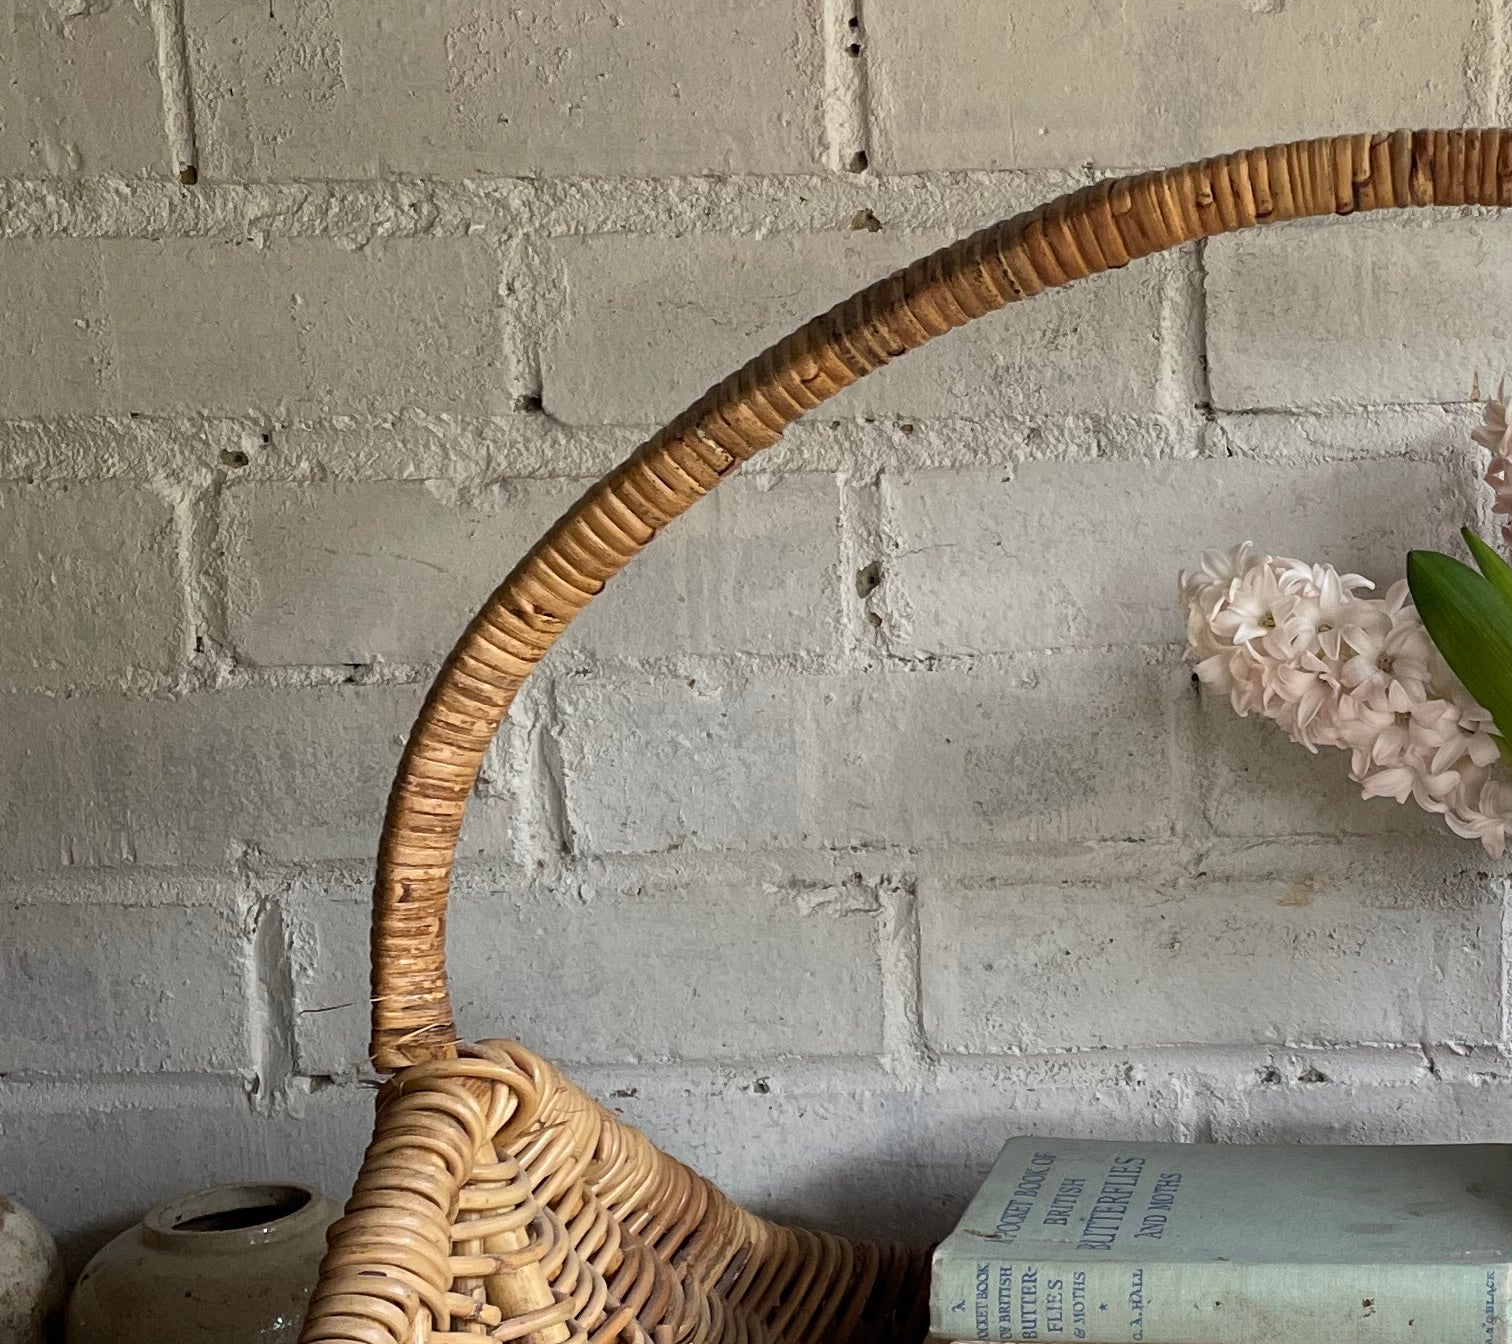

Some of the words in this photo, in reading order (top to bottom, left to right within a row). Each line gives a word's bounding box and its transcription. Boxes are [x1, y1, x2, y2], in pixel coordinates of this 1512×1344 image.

[1014, 1168, 1048, 1198] BOOK
[1032, 1152, 1056, 1167] OF
[1147, 1172, 1183, 1211] MOTHS
[1043, 1177, 1086, 1226] BRITISH
[1075, 1156, 1145, 1251] BUTTERFLIES
[1133, 1215, 1168, 1240] AND
[976, 1263, 990, 1301] BOOK
[998, 1265, 1013, 1324] BRITISH
[1020, 1266, 1038, 1340] BUTTER-
[1072, 1271, 1086, 1326] MOTHS
[951, 1299, 966, 1314] A
[975, 1304, 990, 1341] OCKET
[1046, 1279, 1063, 1333] FLIES
[1073, 1327, 1086, 1339] &
